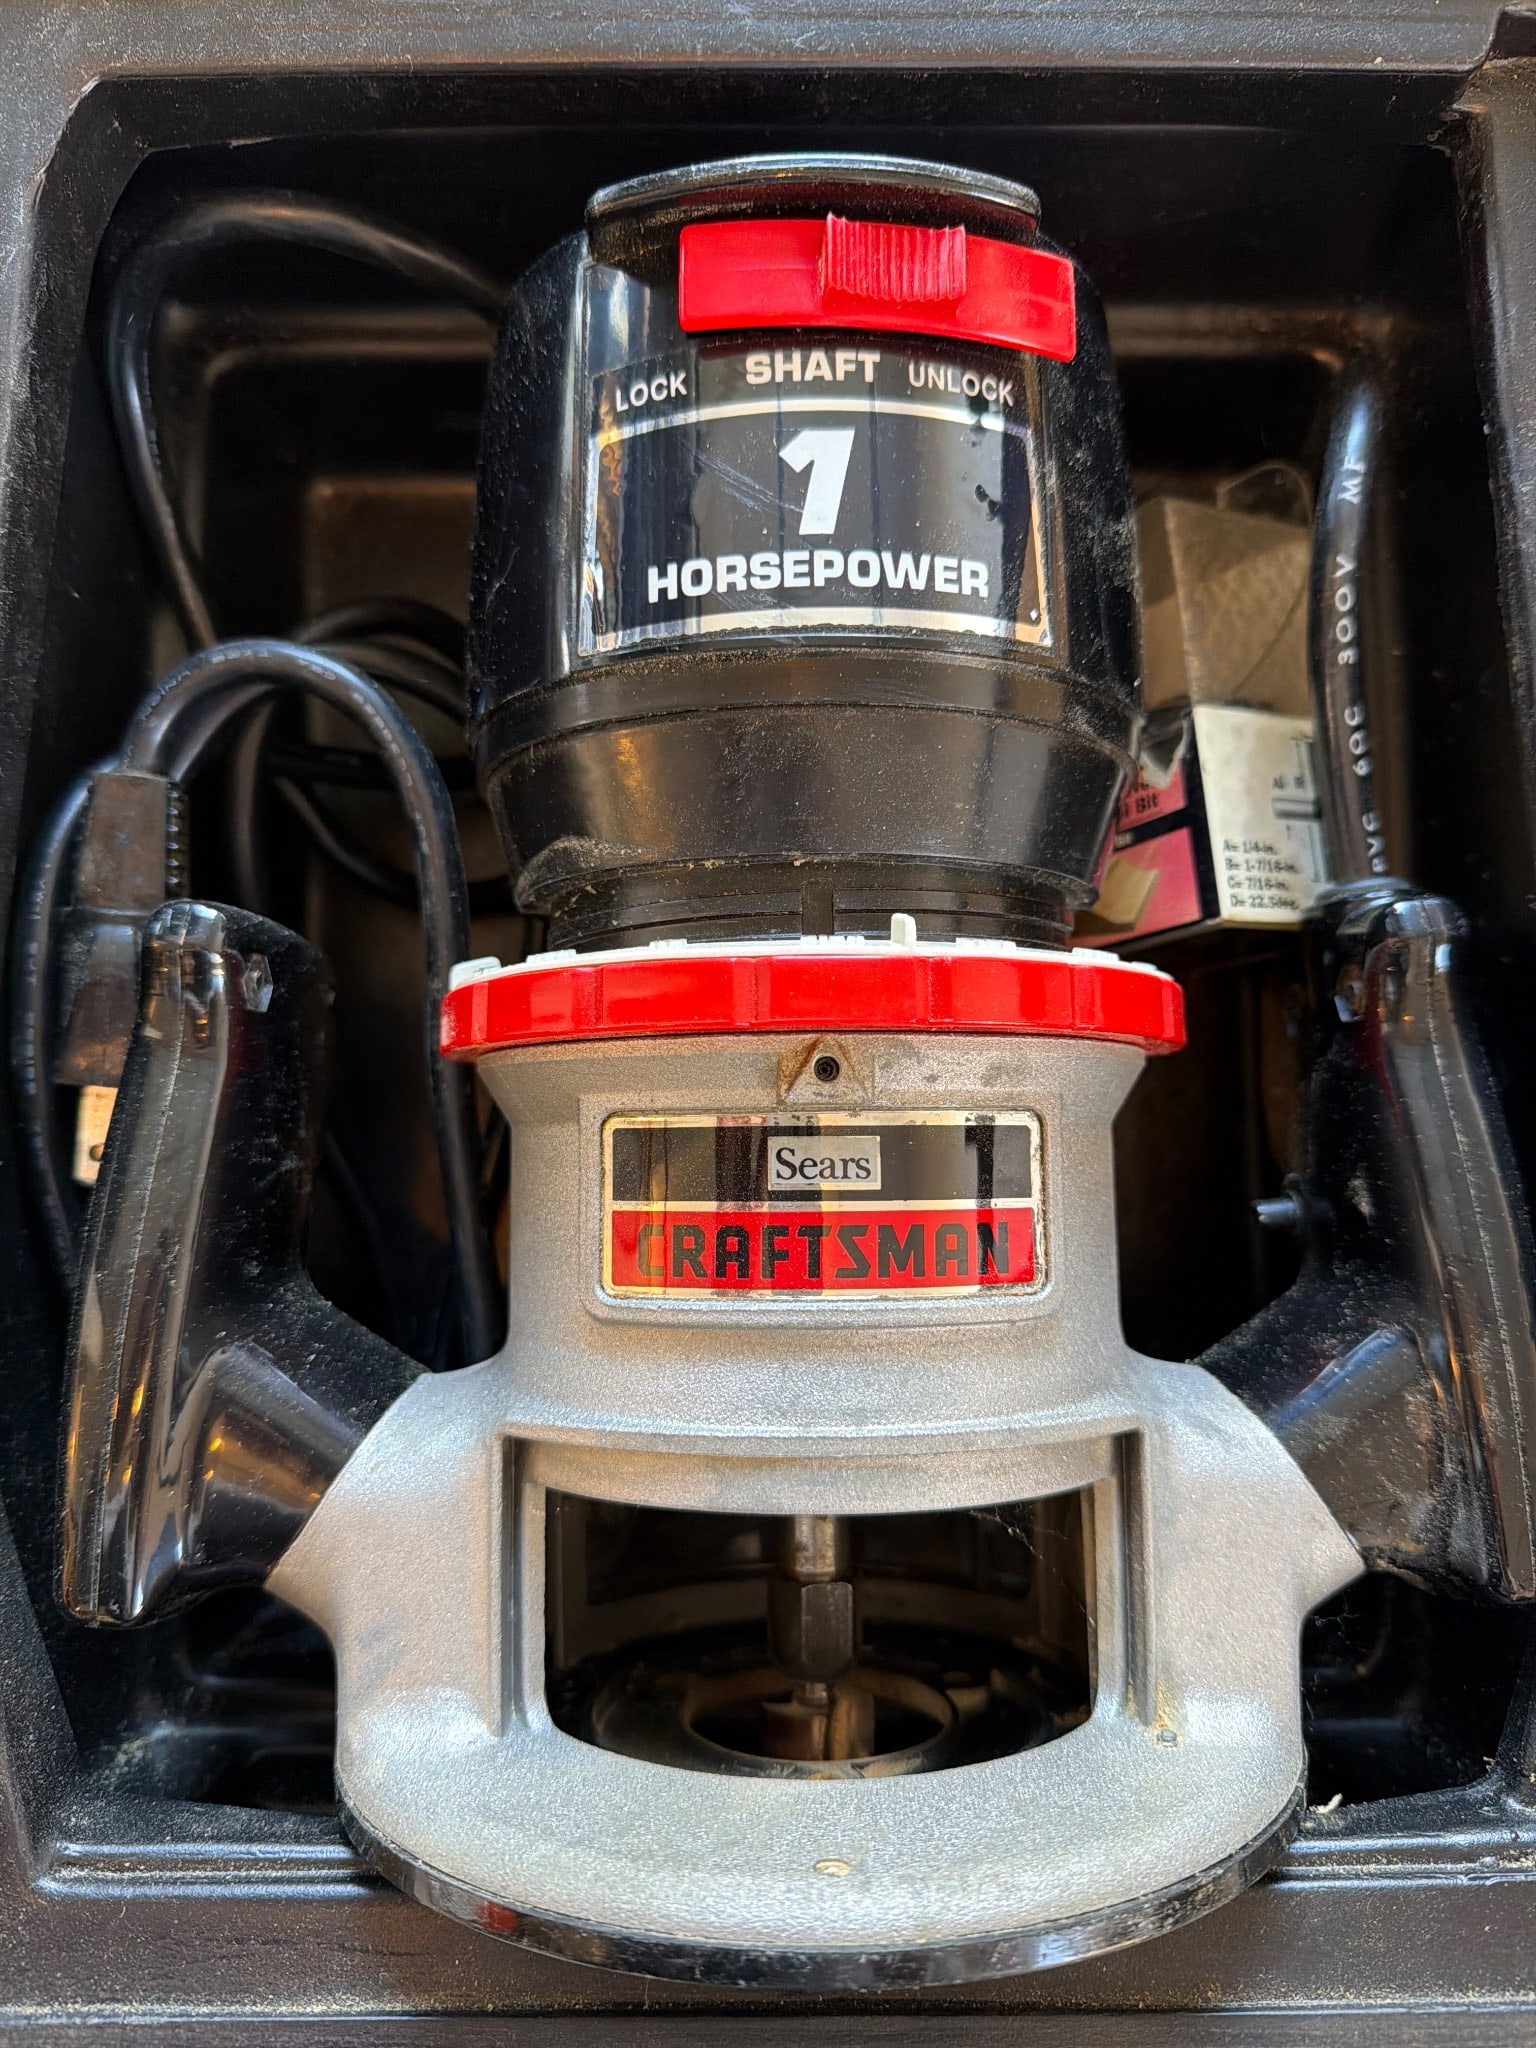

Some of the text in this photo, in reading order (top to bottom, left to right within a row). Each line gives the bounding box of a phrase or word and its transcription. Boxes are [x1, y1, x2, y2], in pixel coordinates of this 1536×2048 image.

[615, 350, 1014, 413] LOCK SHAFT UNLOCK
[778, 427, 856, 535] 1
[647, 550, 990, 603] HORSEPOWER
[1333, 553, 1359, 665] 300V
[775, 1148, 872, 1182] Sears
[637, 1222, 1009, 1279] CRAFTSMAN
